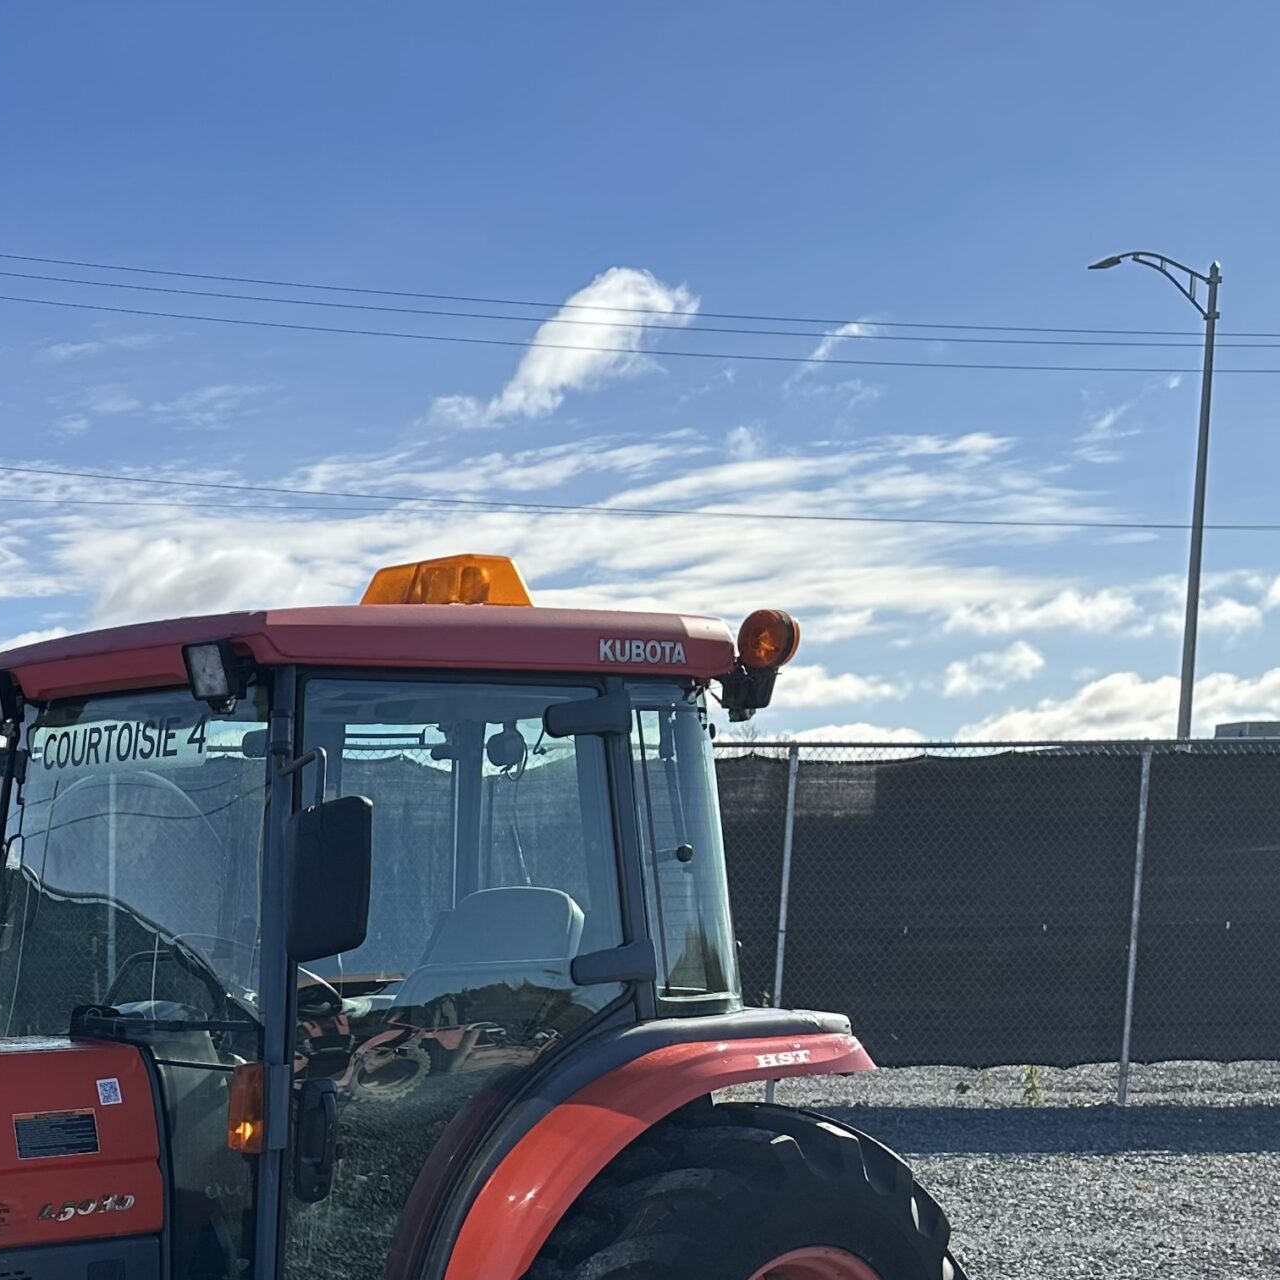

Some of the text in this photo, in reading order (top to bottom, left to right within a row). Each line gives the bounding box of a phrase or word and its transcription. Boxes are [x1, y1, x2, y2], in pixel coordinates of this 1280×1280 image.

[599, 638, 687, 664] KUBOTA
[43, 714, 207, 770] COURTOISIE 4
[754, 1049, 811, 1068] HST
